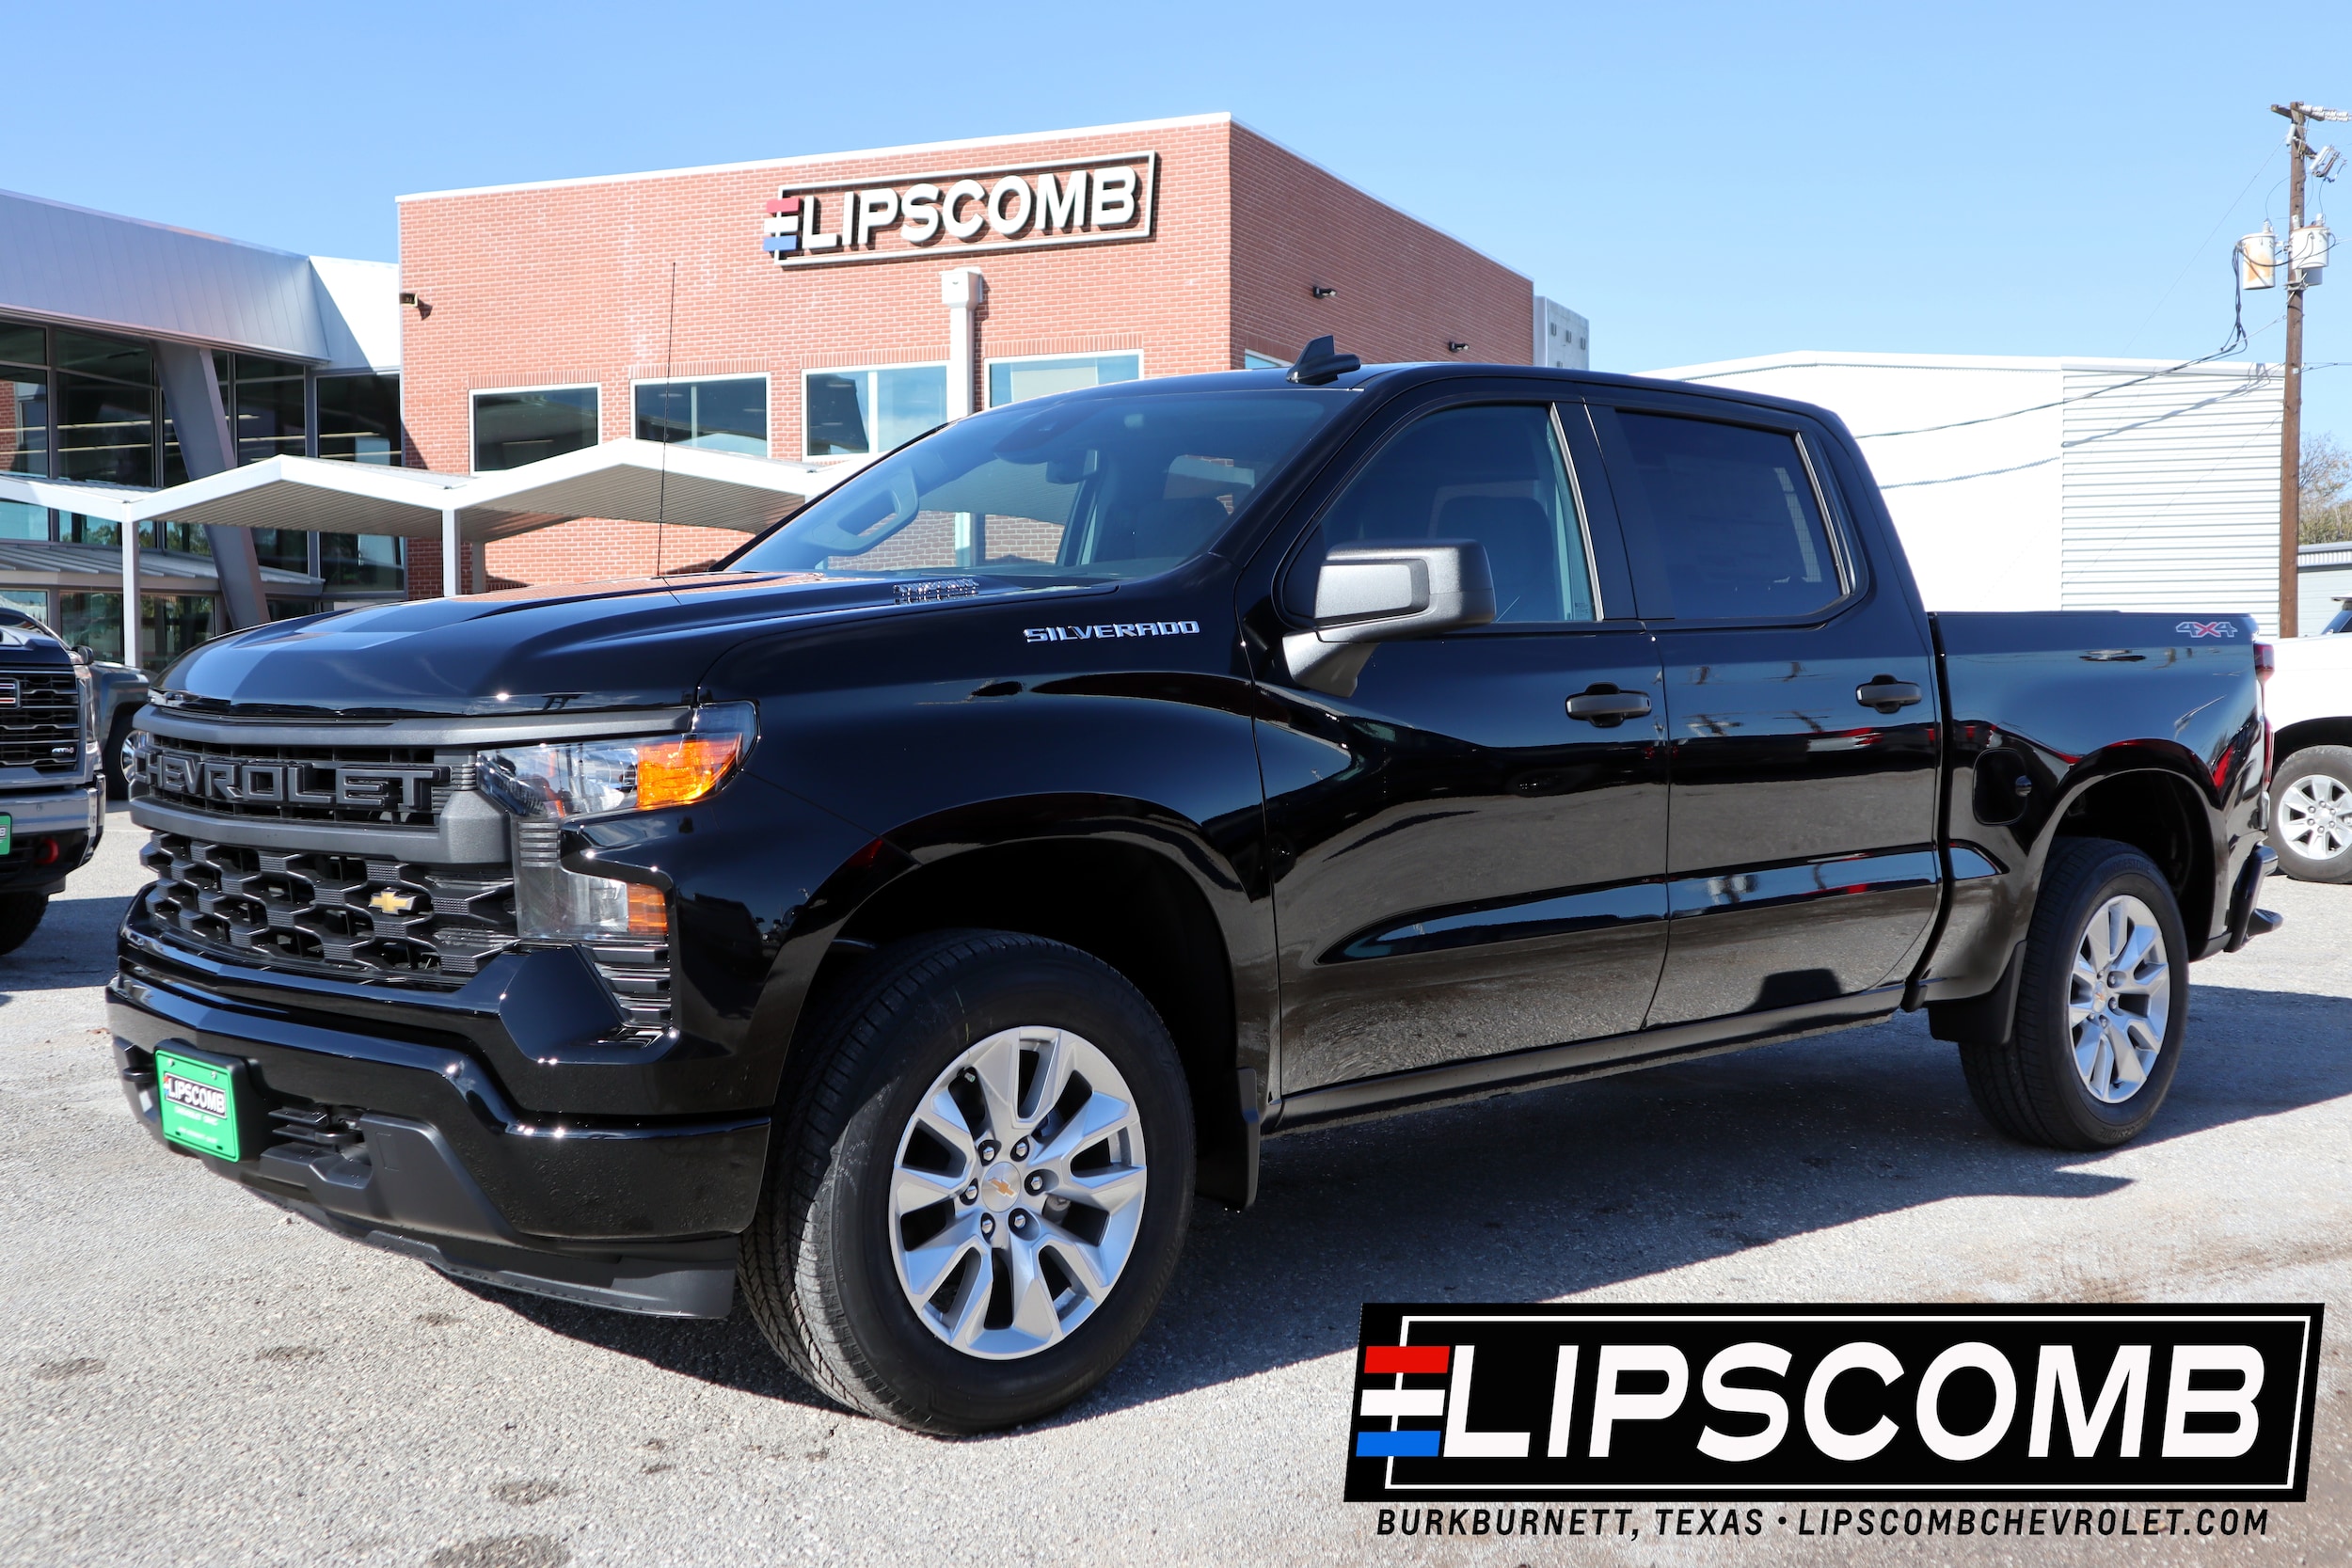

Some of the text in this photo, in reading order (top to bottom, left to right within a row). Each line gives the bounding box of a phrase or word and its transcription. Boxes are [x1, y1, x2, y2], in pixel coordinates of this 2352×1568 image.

[803, 166, 1138, 249] LIPSCOMB
[1024, 621, 1200, 642] SILVERADO
[167, 1077, 225, 1114] LIPSCOMB
